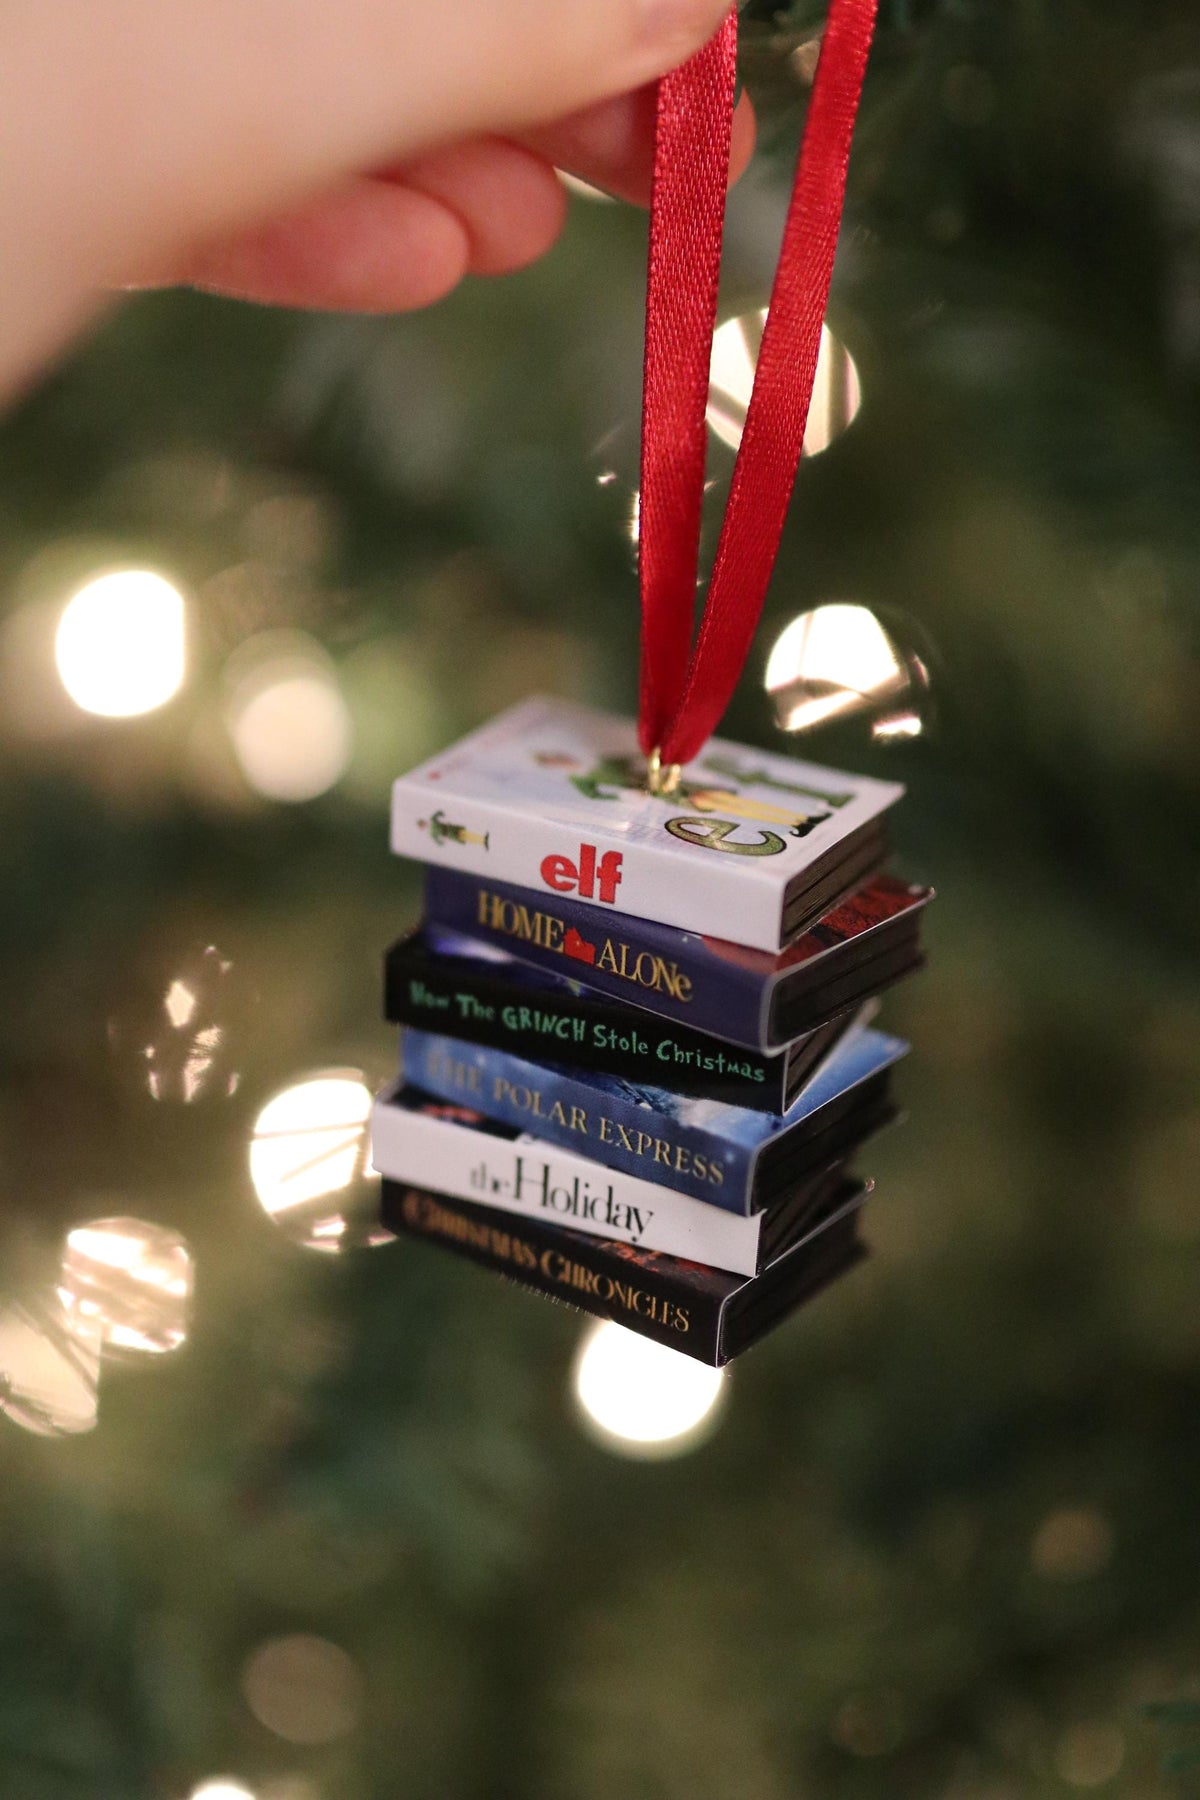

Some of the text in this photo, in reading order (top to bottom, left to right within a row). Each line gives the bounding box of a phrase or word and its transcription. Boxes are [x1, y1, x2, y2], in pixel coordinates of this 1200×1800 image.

[540, 843, 623, 904] elf
[477, 890, 566, 954] HOME
[409, 981, 449, 1008] How
[456, 993, 495, 1020] The
[501, 1005, 586, 1042] GRINCH
[593, 1024, 649, 1056] Stole
[428, 1050, 725, 1187] THE POLAR EXPRESS
[513, 1156, 654, 1243] Holiday
